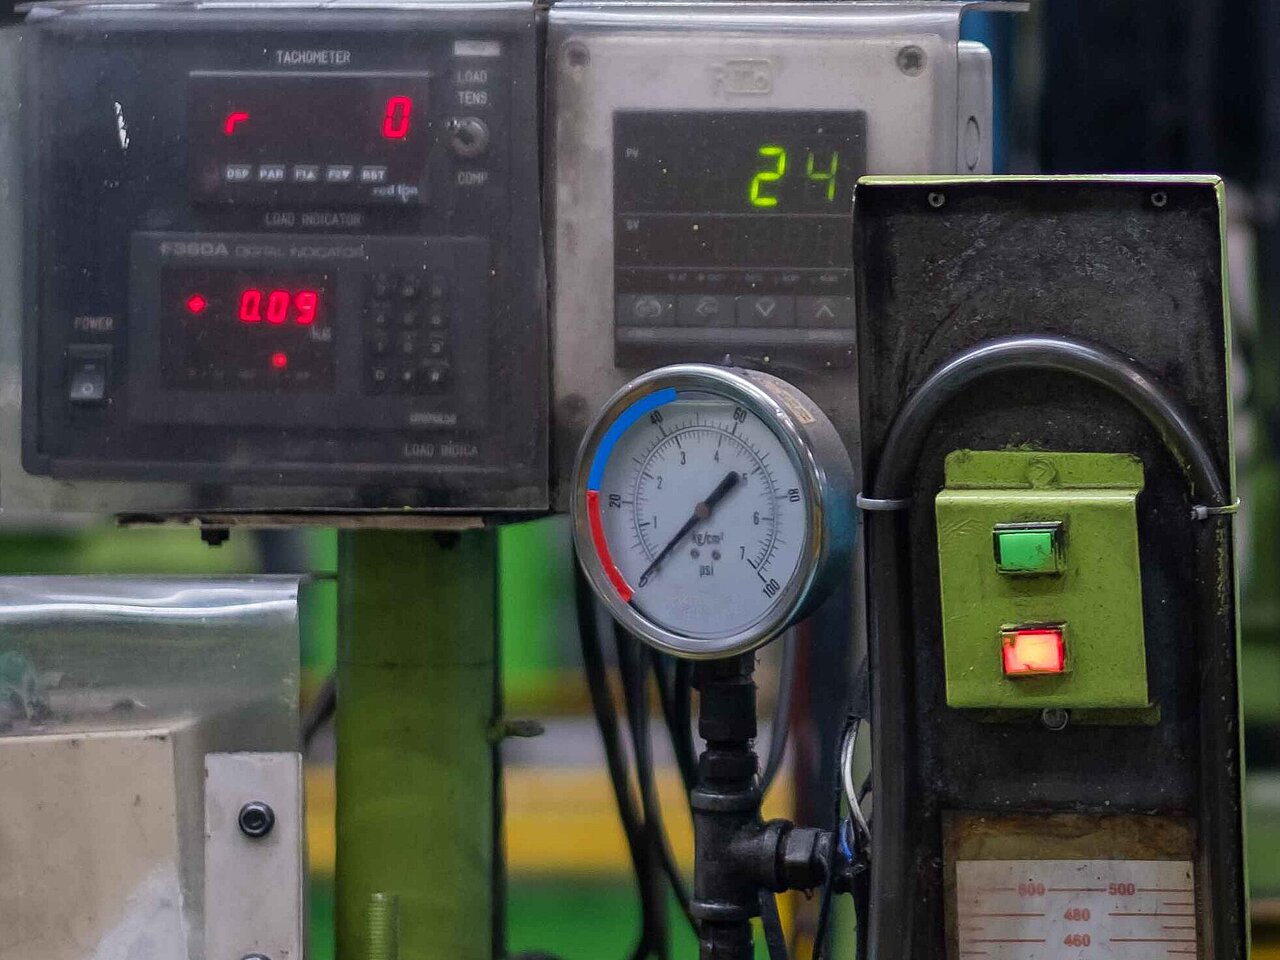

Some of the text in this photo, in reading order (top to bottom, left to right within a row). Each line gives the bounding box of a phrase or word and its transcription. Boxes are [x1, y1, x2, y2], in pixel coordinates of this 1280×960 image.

[277, 49, 351, 64] TACHOMETER
[456, 69, 488, 83] LOAD
[457, 91, 488, 105] TENS
[382, 95, 413, 140] 0
[457, 171, 488, 185] COMP
[749, 145, 839, 208] 24
[301, 211, 363, 227] INDICATOR
[73, 316, 114, 330] POWER
[650, 409, 664, 425] 40
[733, 407, 747, 422] 60
[680, 451, 687, 465] 3
[713, 449, 720, 464] 4
[656, 477, 663, 490] 2
[609, 494, 621, 508] 20
[788, 489, 800, 503] 80
[753, 512, 760, 525] 6
[739, 546, 746, 561] 7
[699, 561, 714, 578] psi
[762, 578, 781, 599] 100
[1108, 882, 1136, 896] 500
[1063, 907, 1091, 922] 480
[1063, 933, 1091, 947] 460
